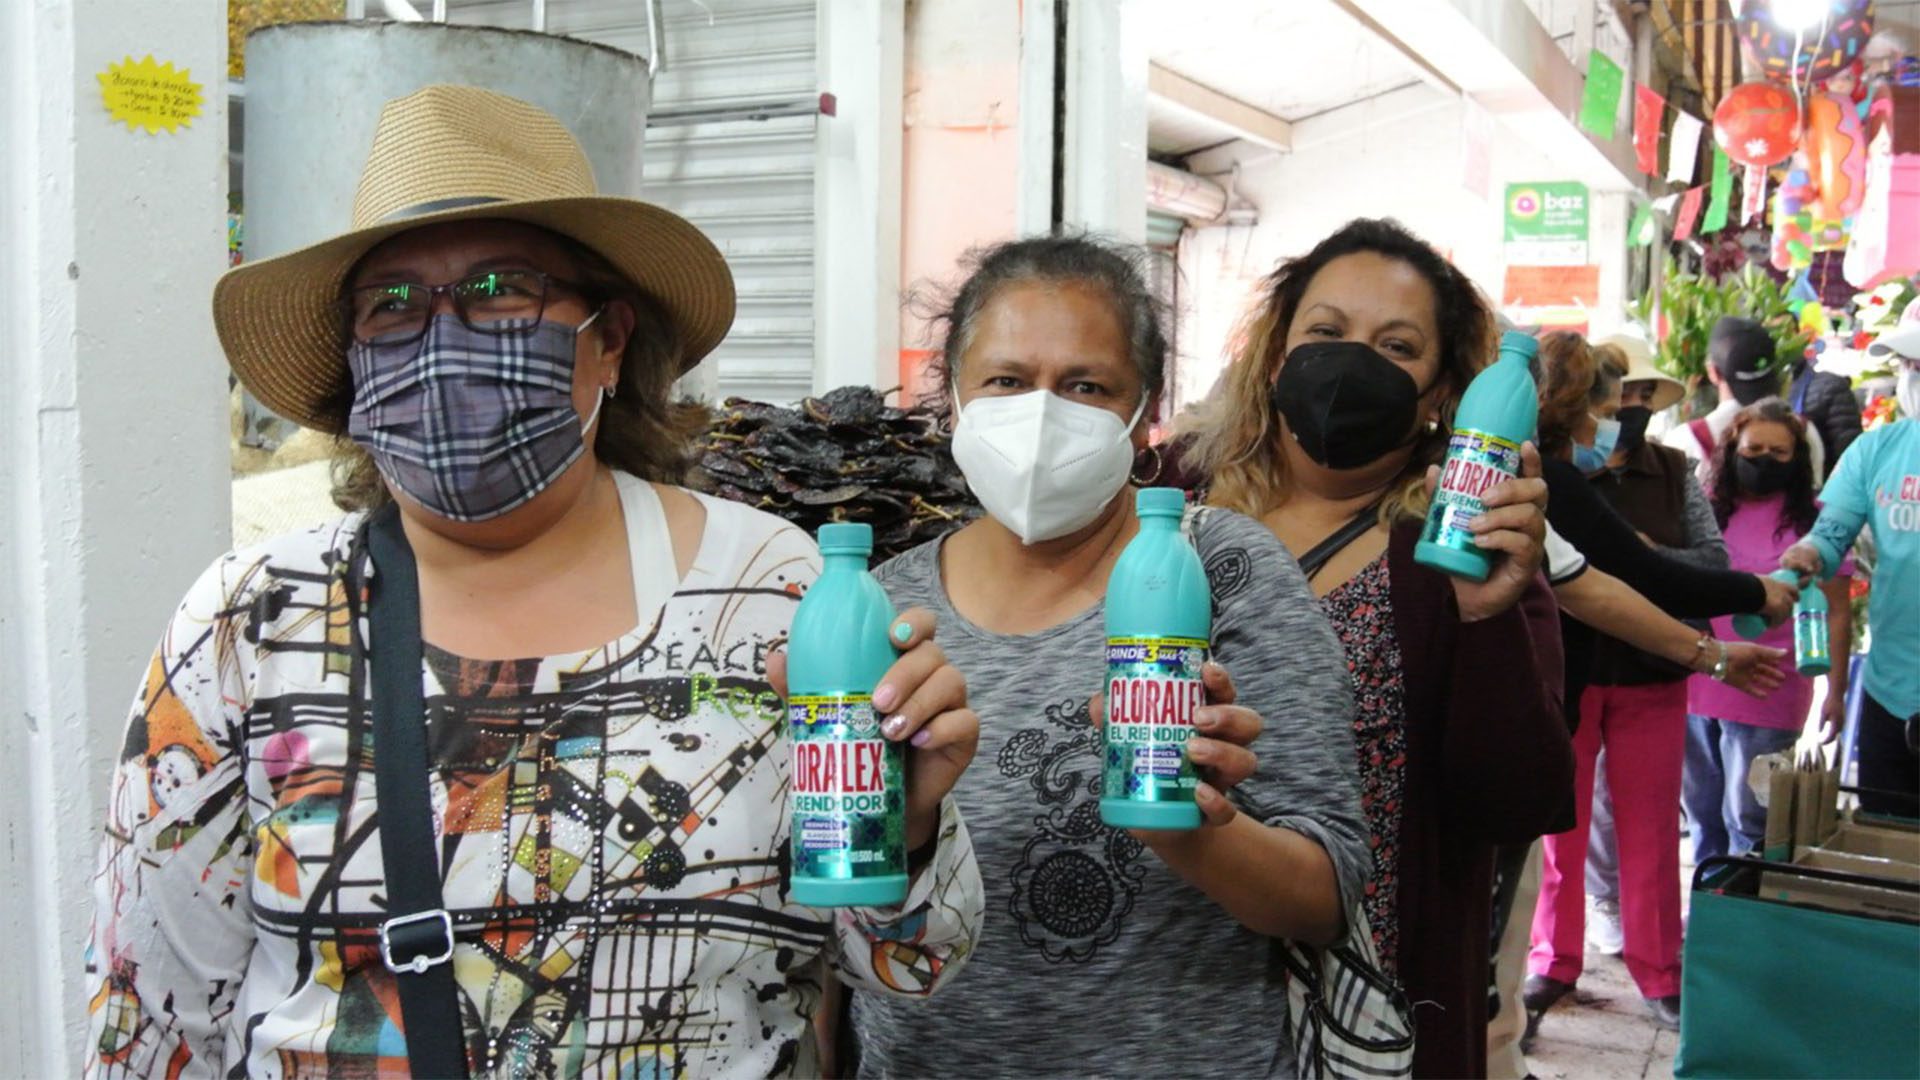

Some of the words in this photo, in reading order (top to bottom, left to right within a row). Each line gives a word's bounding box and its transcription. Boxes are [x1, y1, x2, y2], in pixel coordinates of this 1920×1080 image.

[1544, 192, 1584, 209] baz
[637, 641, 768, 674] PEACE
[1144, 645, 1159, 663] 3
[1110, 679, 1204, 725] CLORALE
[804, 704, 818, 725] 3
[1110, 726, 1121, 740] EL
[1127, 726, 1198, 742] RENDIDO
[796, 794, 882, 812] RENDDOR
